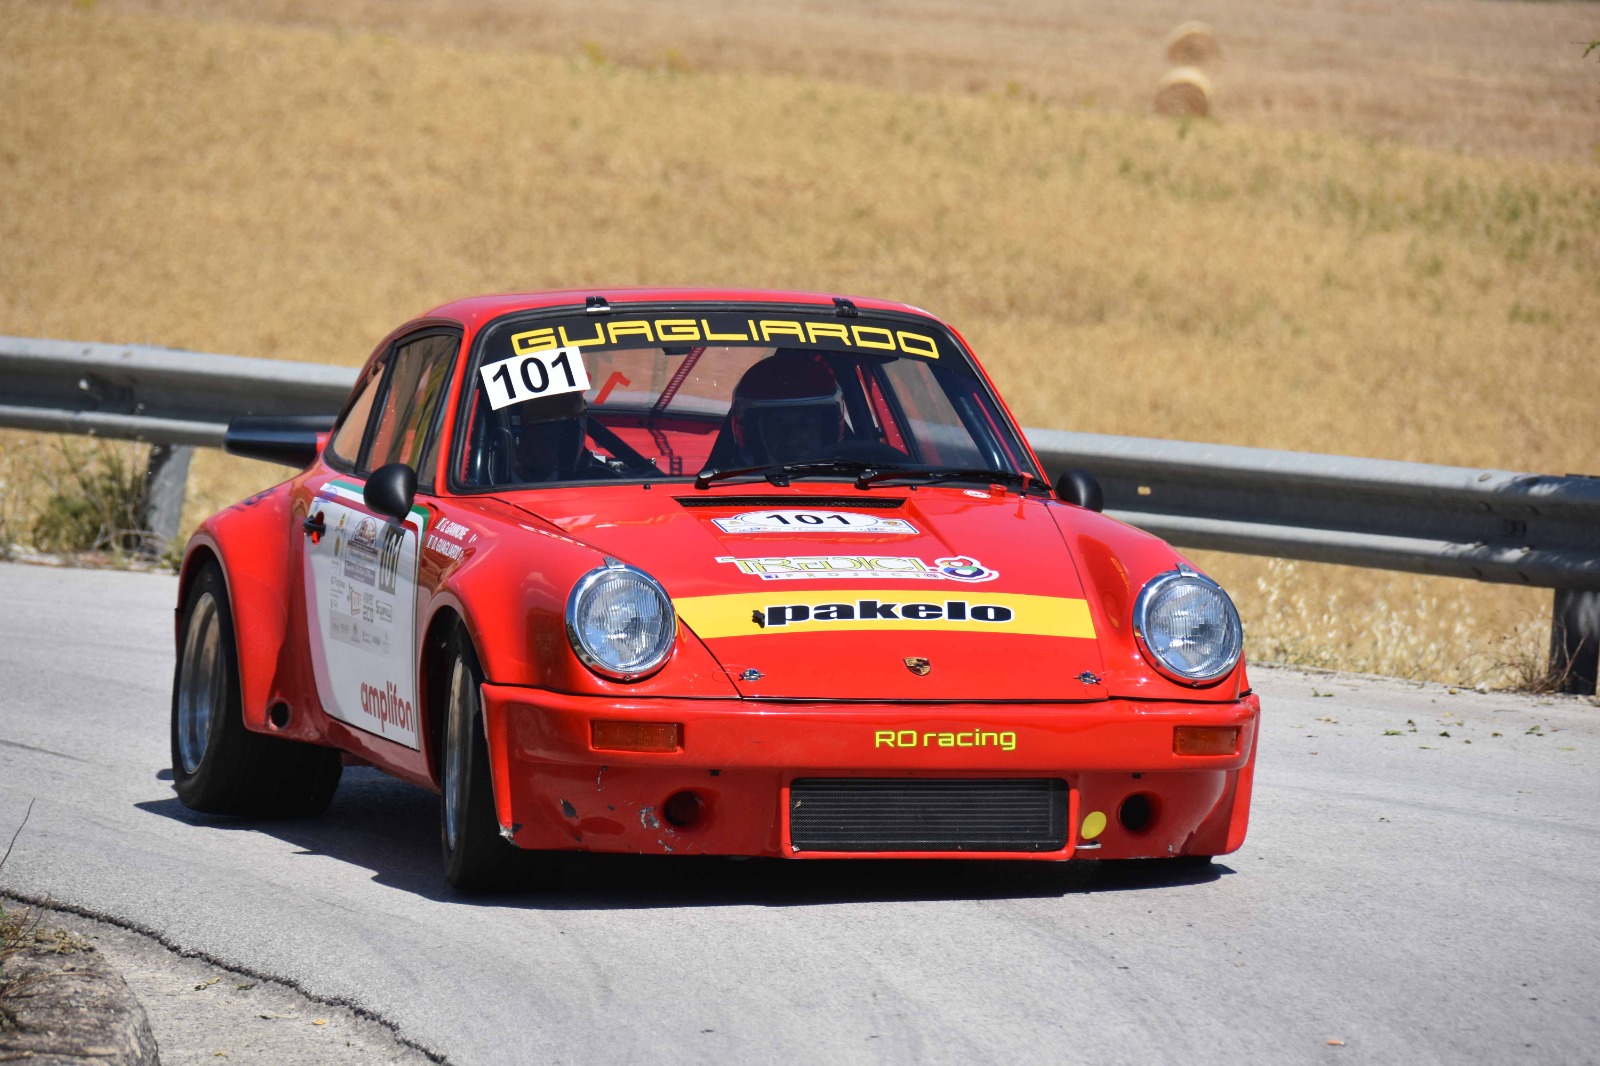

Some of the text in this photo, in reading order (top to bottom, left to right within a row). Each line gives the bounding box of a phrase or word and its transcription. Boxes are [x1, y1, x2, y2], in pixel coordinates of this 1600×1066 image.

[511, 319, 940, 359] GUAGLIARDO
[491, 350, 578, 401] 101
[766, 514, 851, 525] 101
[381, 531, 404, 588] 101
[766, 600, 1013, 626] pakelo
[361, 681, 414, 733] amplifon
[875, 728, 1017, 751] RO racing
